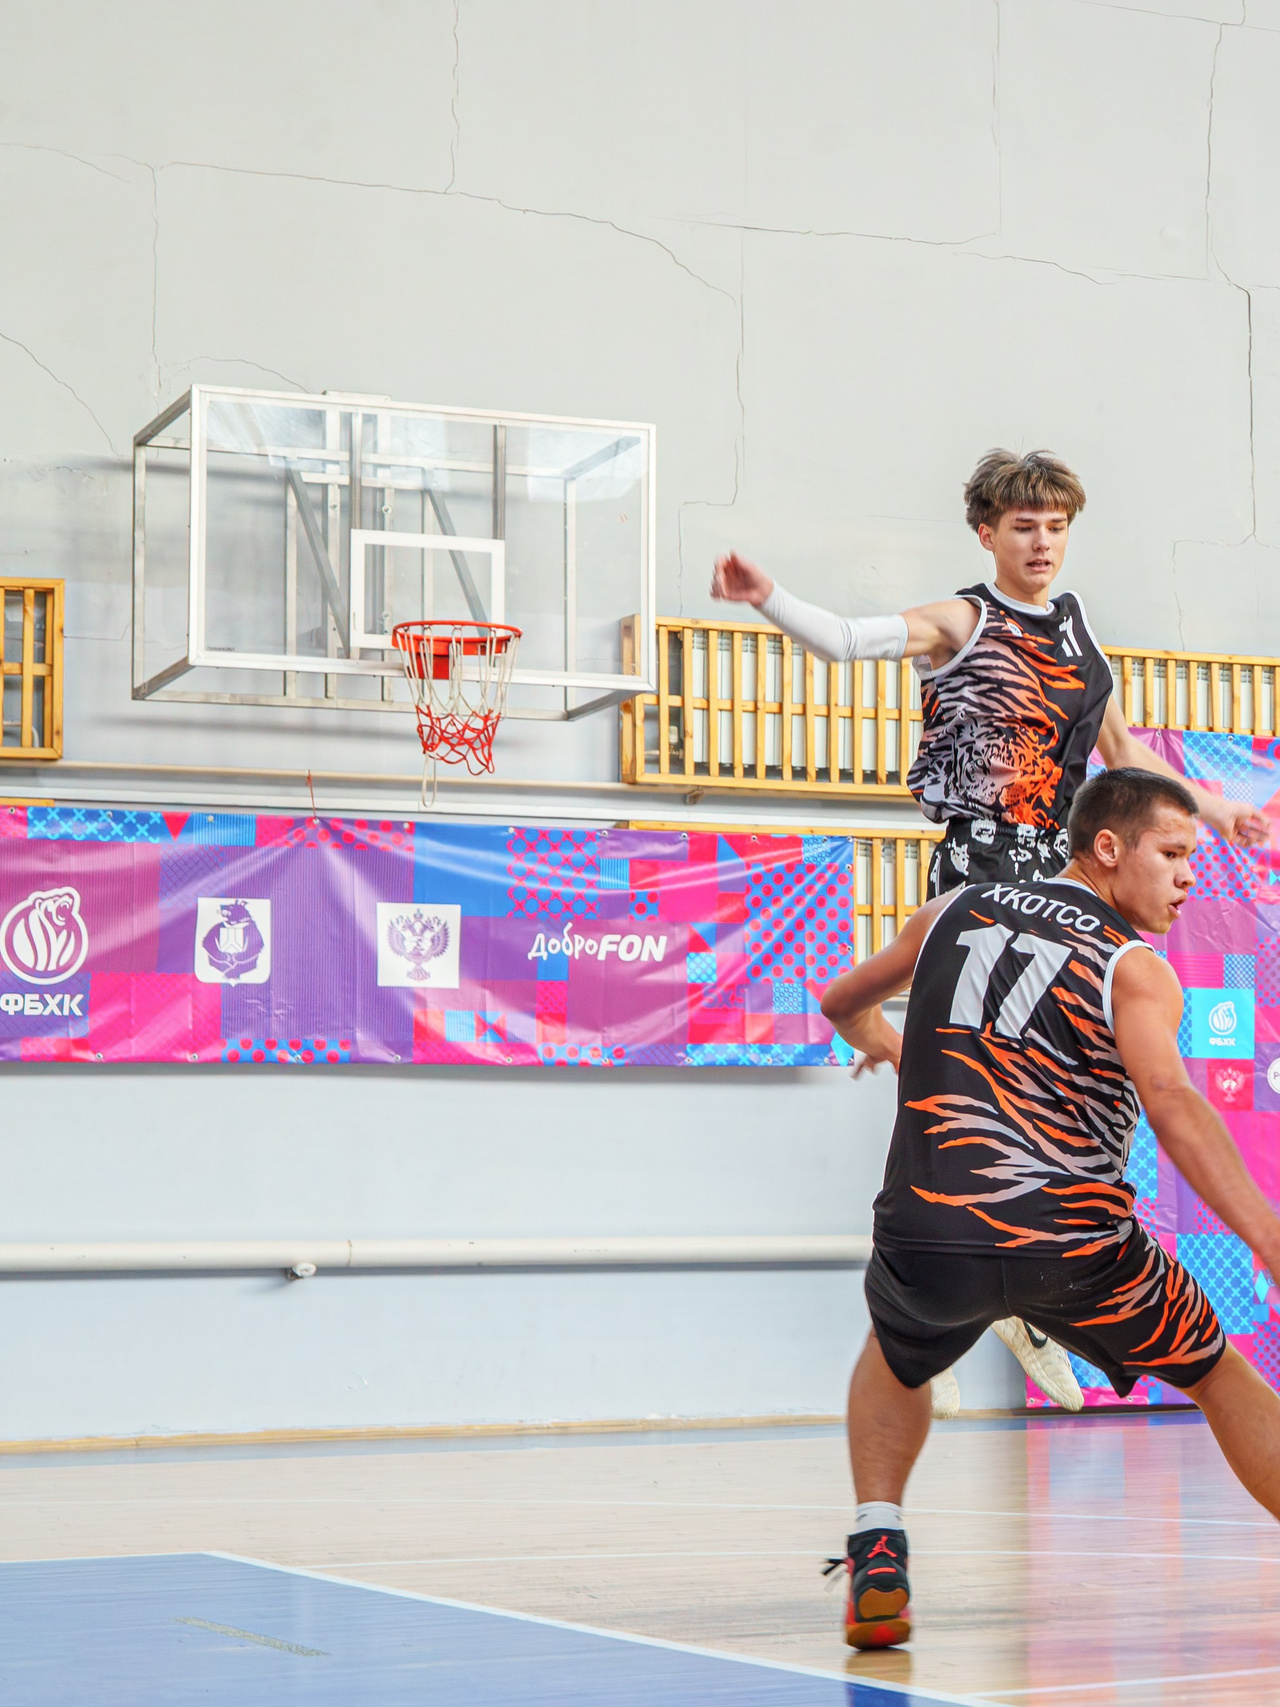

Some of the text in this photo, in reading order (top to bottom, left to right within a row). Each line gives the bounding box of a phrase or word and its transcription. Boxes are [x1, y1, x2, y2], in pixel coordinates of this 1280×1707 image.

[527, 921, 668, 962] ДоброFON
[949, 922, 1073, 1040] 17
[0, 993, 84, 1016] ФБХК
